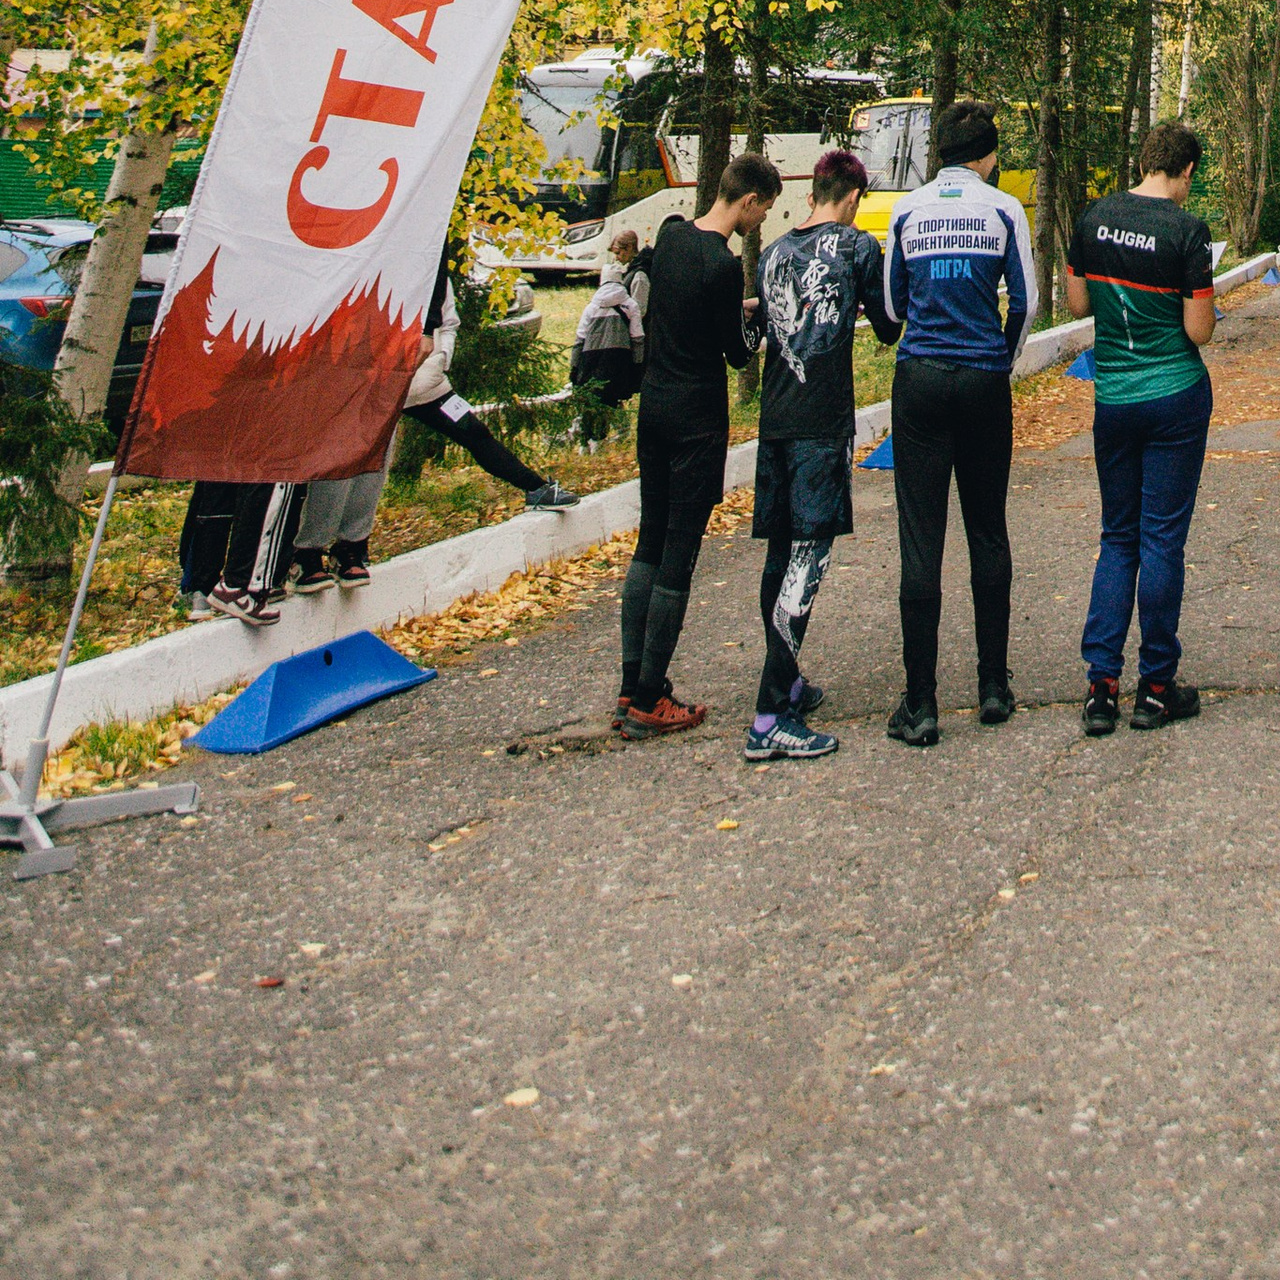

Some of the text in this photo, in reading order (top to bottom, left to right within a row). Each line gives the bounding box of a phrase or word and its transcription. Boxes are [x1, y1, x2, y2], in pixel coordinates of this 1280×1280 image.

[917, 218, 987, 234] СПОРТИВНОЕ
[907, 235, 1000, 254] ОРИЕНТИРОВАНИЕ
[1096, 225, 1156, 251] O-UGRA
[930, 259, 973, 280] ЮГРА
